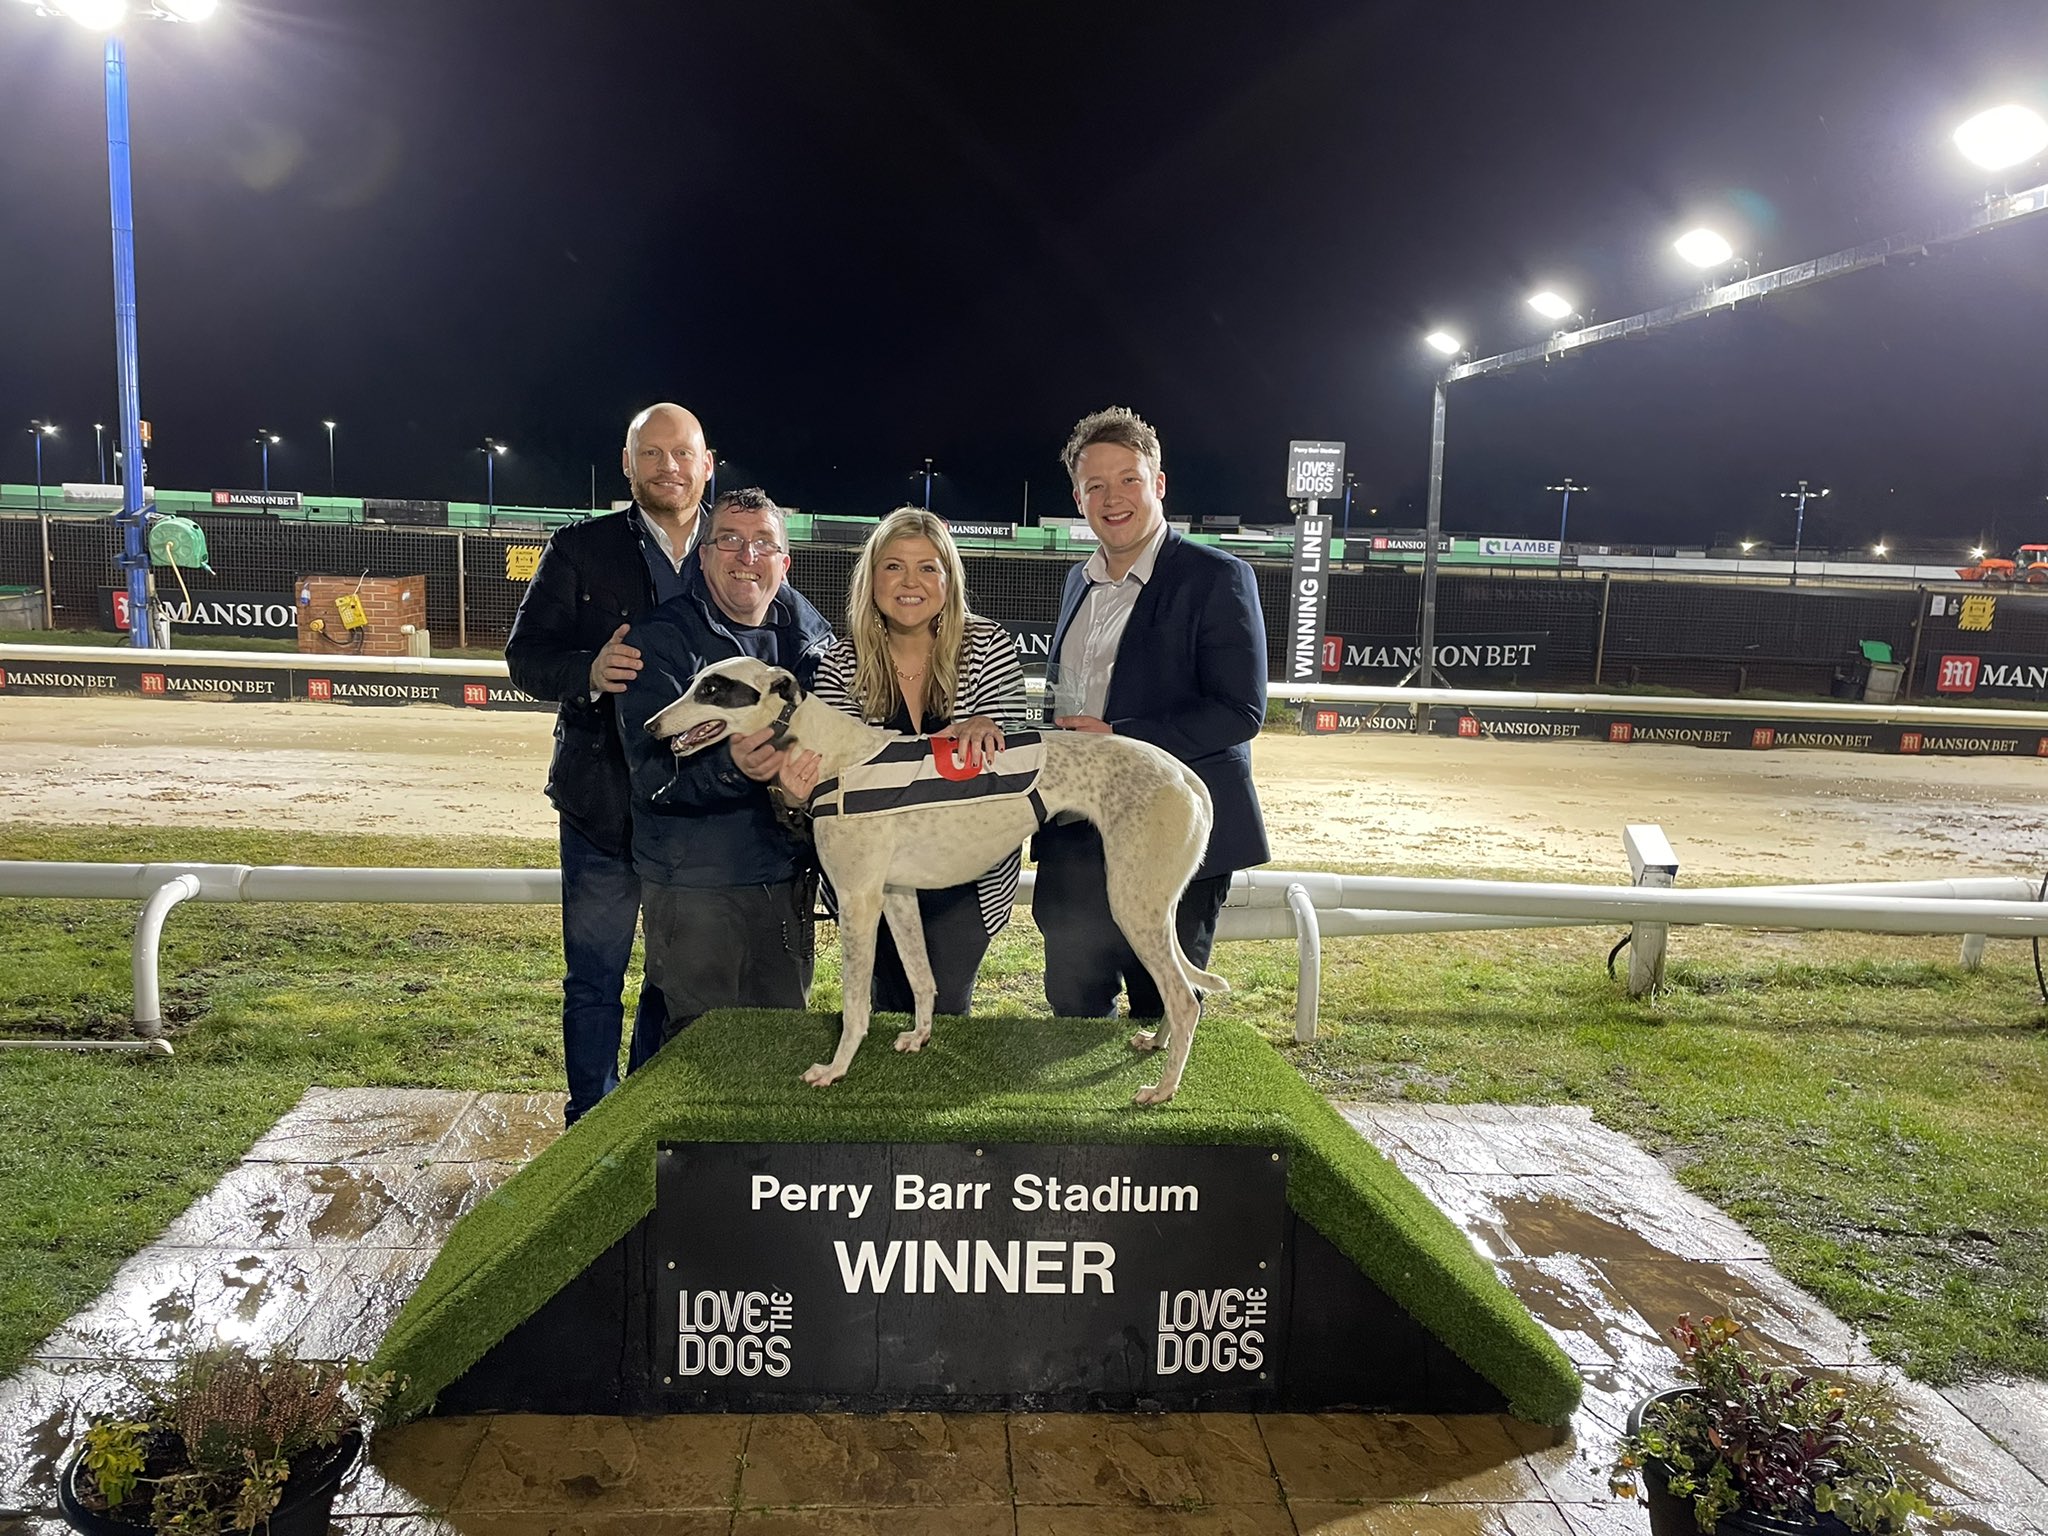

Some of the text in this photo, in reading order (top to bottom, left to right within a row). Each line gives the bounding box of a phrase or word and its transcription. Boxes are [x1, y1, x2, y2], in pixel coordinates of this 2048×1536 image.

[1296, 477, 1334, 493] DOGS
[1297, 461, 1326, 477] LOVE
[1301, 521, 1323, 572] LINE
[1504, 540, 1556, 553] LAMBE
[1294, 578, 1320, 678] WINNING
[751, 1174, 1200, 1219] Perry Barr Stadium
[834, 1240, 1116, 1294] WINNER
[679, 1290, 769, 1333] LOVE
[770, 1291, 794, 1333] THE
[1158, 1288, 1244, 1332] LOVE
[1244, 1287, 1267, 1328] THE
[679, 1335, 792, 1377] DOGS
[1156, 1331, 1265, 1375] DOGS
